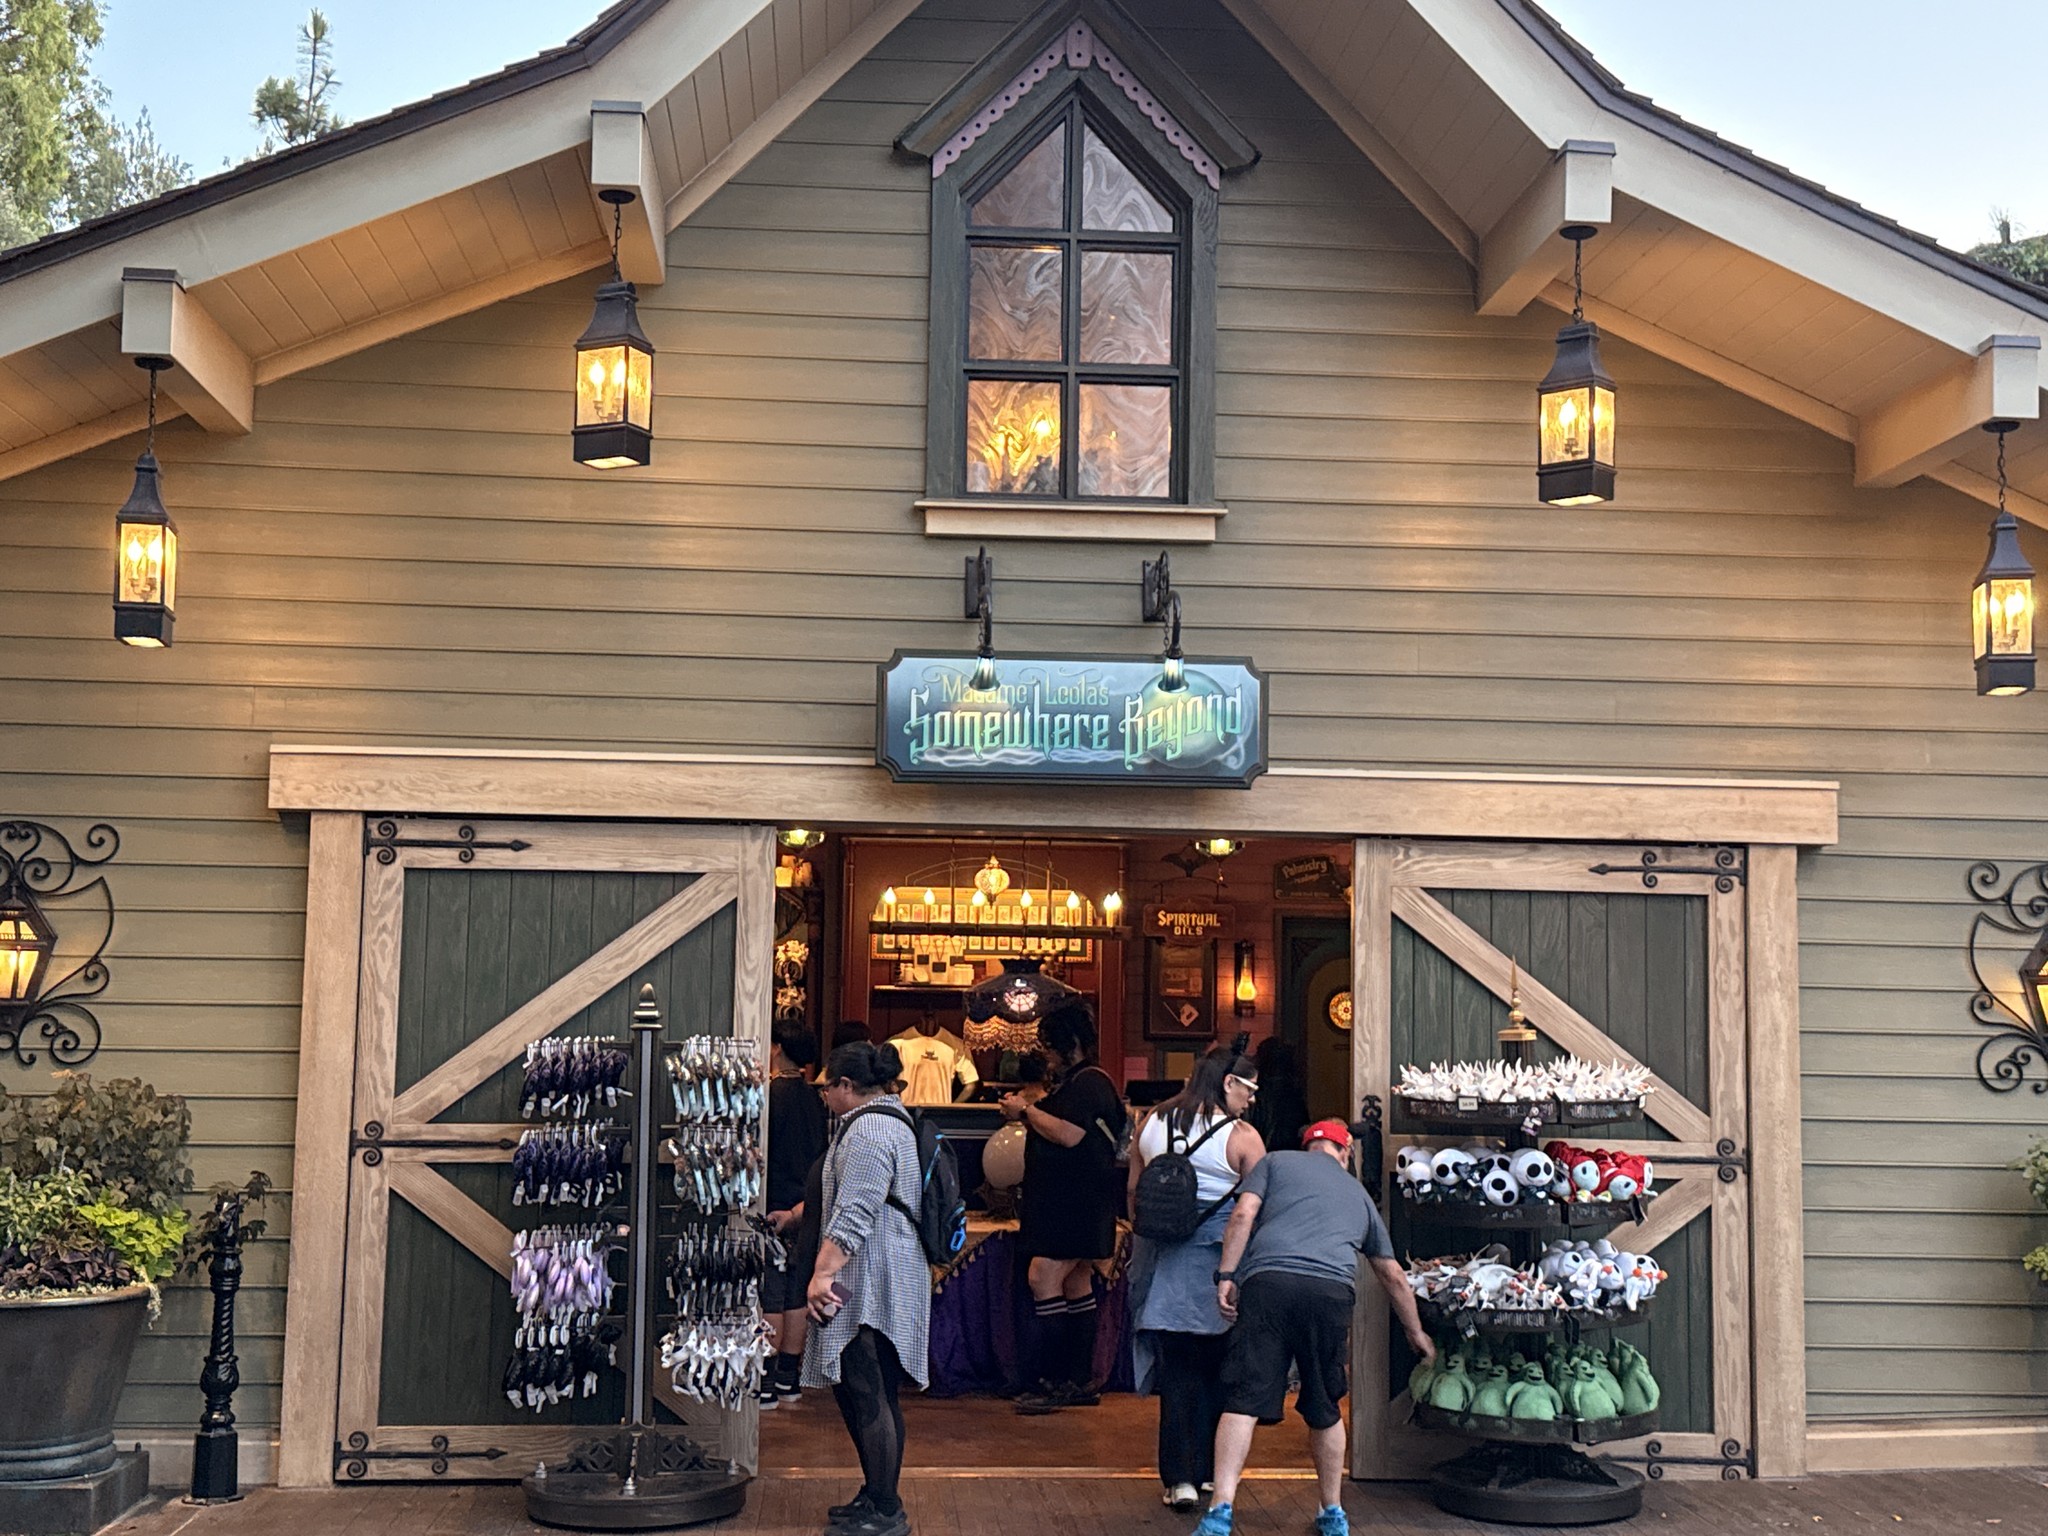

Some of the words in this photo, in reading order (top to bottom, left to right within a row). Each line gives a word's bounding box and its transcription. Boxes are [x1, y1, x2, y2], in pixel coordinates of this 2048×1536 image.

[903, 680, 1110, 765] Somewhere
[1118, 684, 1243, 771] Beyond
[1157, 909, 1221, 927] SPIRITUAL
[1174, 925, 1203, 936] OILS
